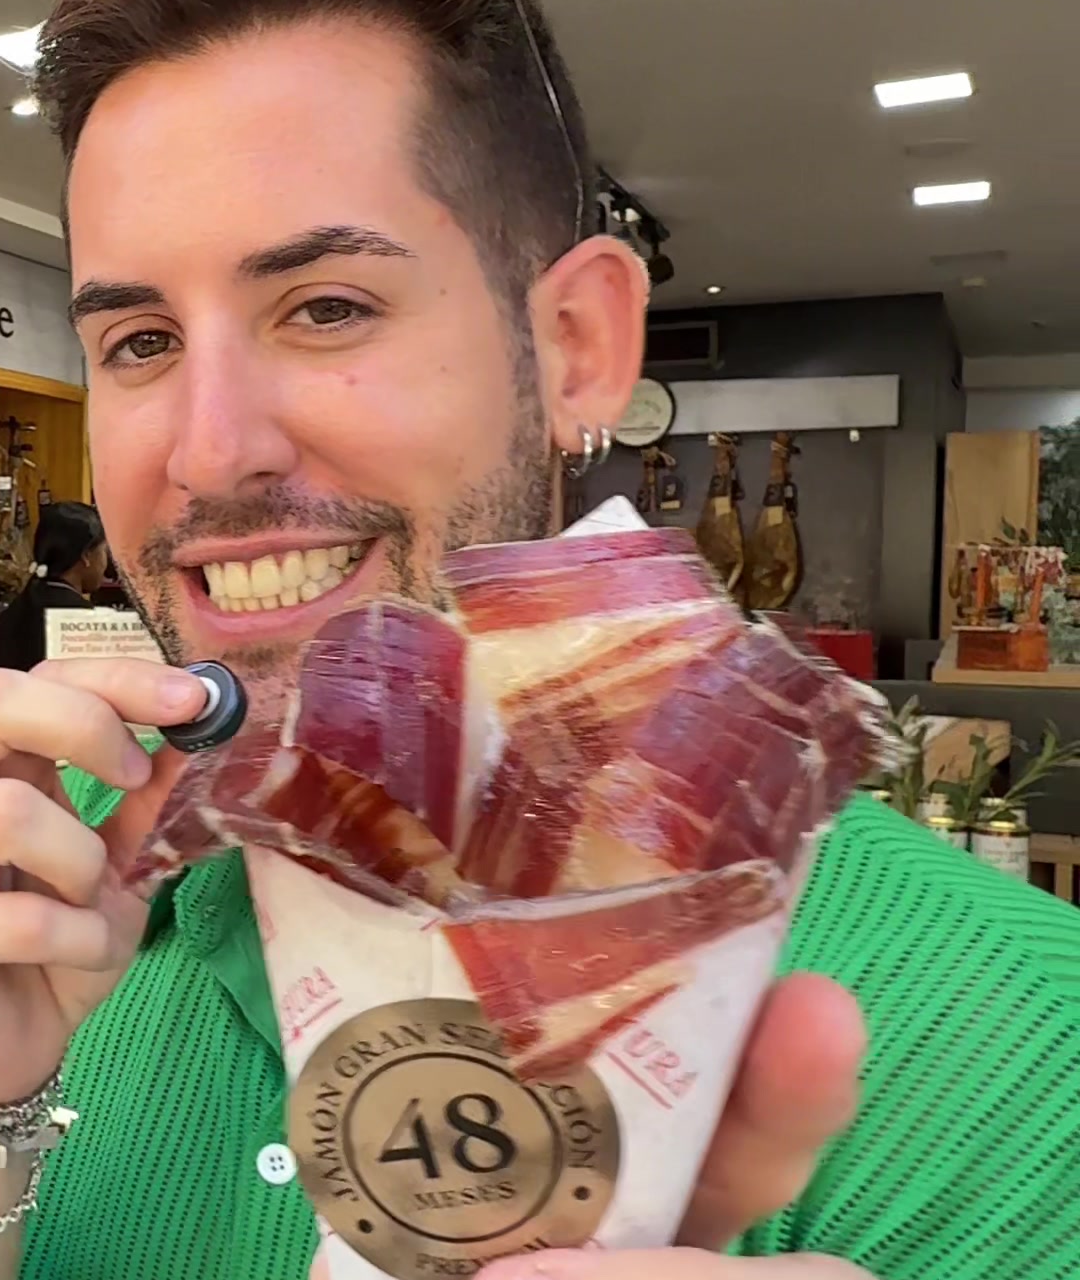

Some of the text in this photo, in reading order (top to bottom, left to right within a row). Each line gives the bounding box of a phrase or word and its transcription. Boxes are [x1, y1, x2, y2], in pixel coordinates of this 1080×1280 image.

[61, 622, 107, 631] BOCATA
[334, 1023, 429, 1078] GRAN
[310, 1082, 360, 1202] JAMÓN
[378, 1093, 517, 1179] 48
[415, 1181, 516, 1210] MESES
